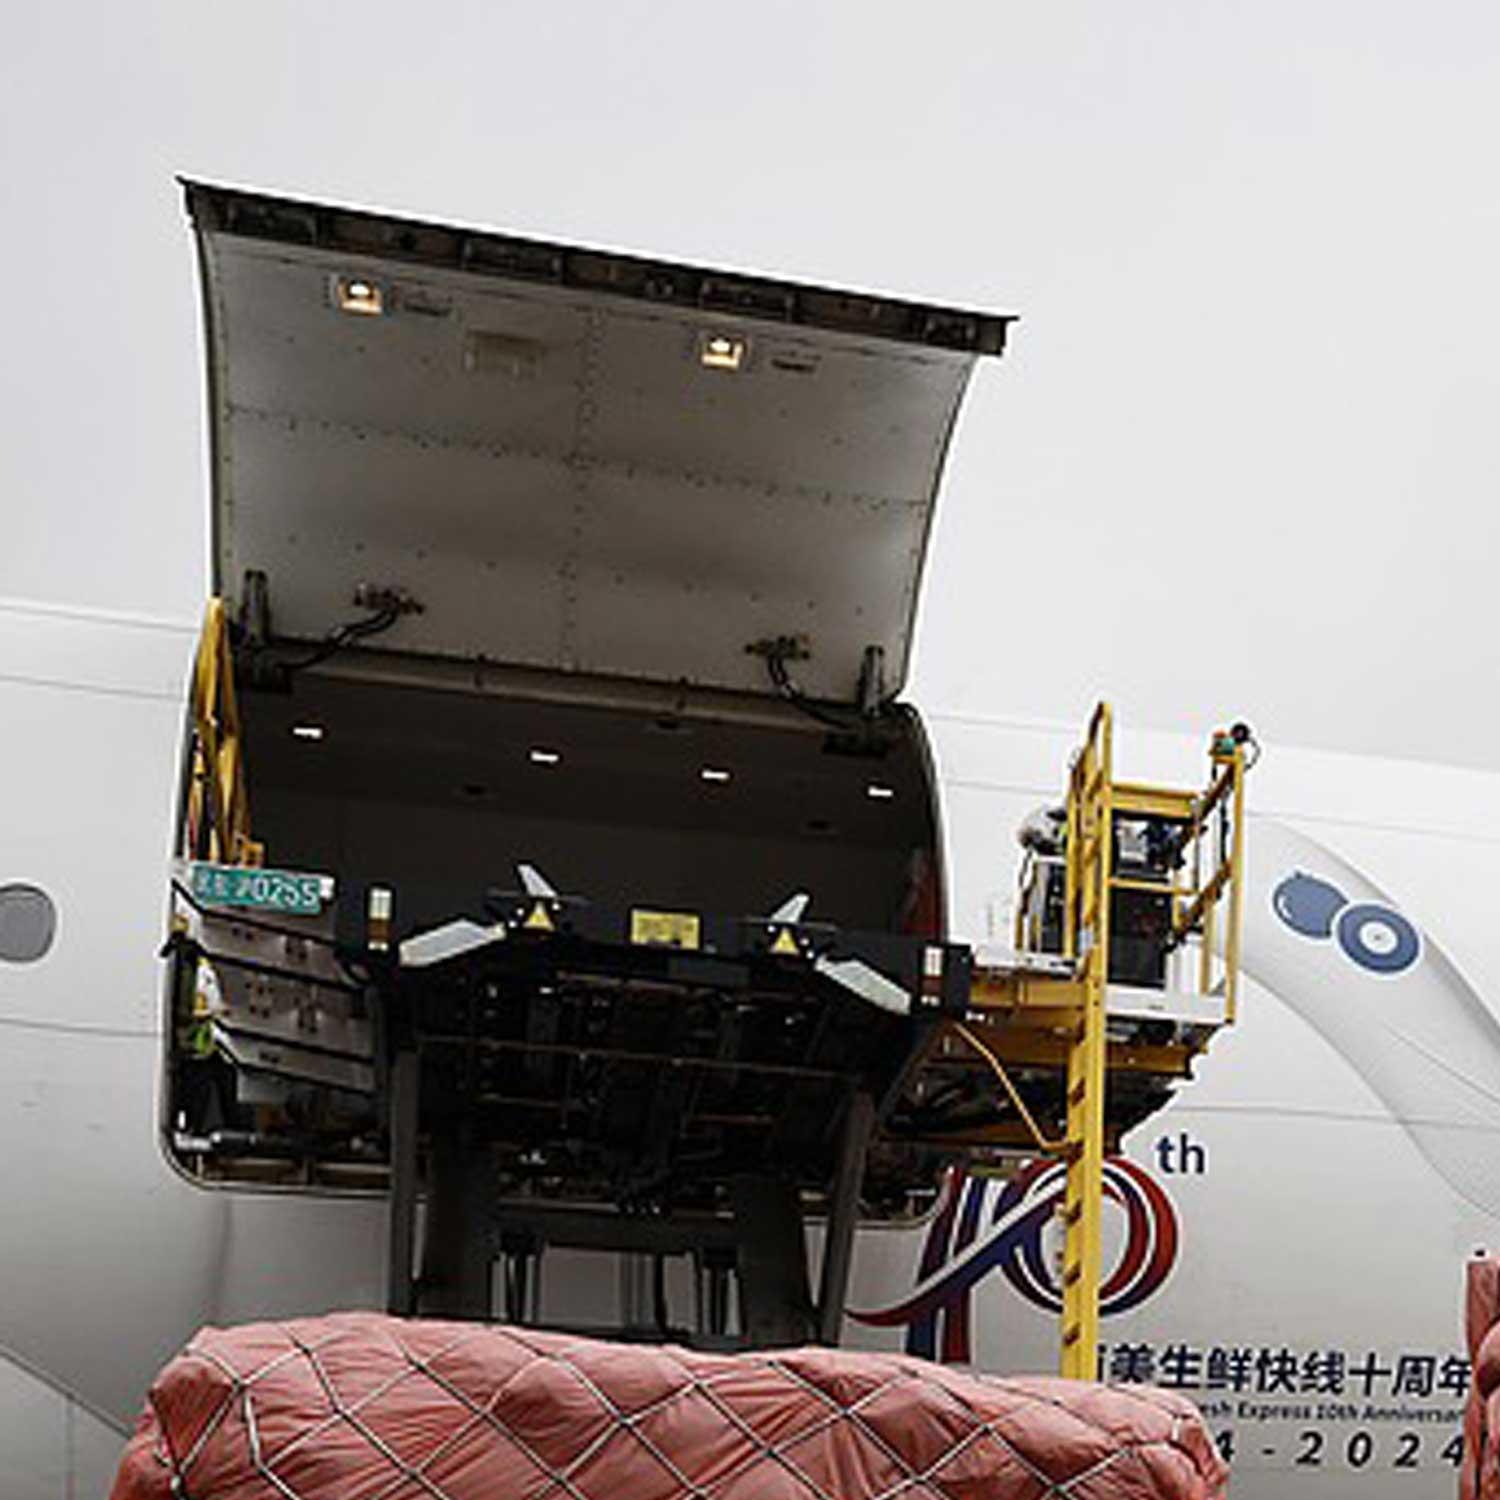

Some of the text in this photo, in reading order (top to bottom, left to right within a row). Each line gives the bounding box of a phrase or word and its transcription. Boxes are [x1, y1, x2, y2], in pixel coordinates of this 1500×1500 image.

[1096, 1343, 1472, 1398] 美生鲜快线十周年
[1237, 1402, 1311, 1423] Express
[1316, 1404, 1359, 1421] 10th
[1361, 1404, 1467, 1424] Anniversar
